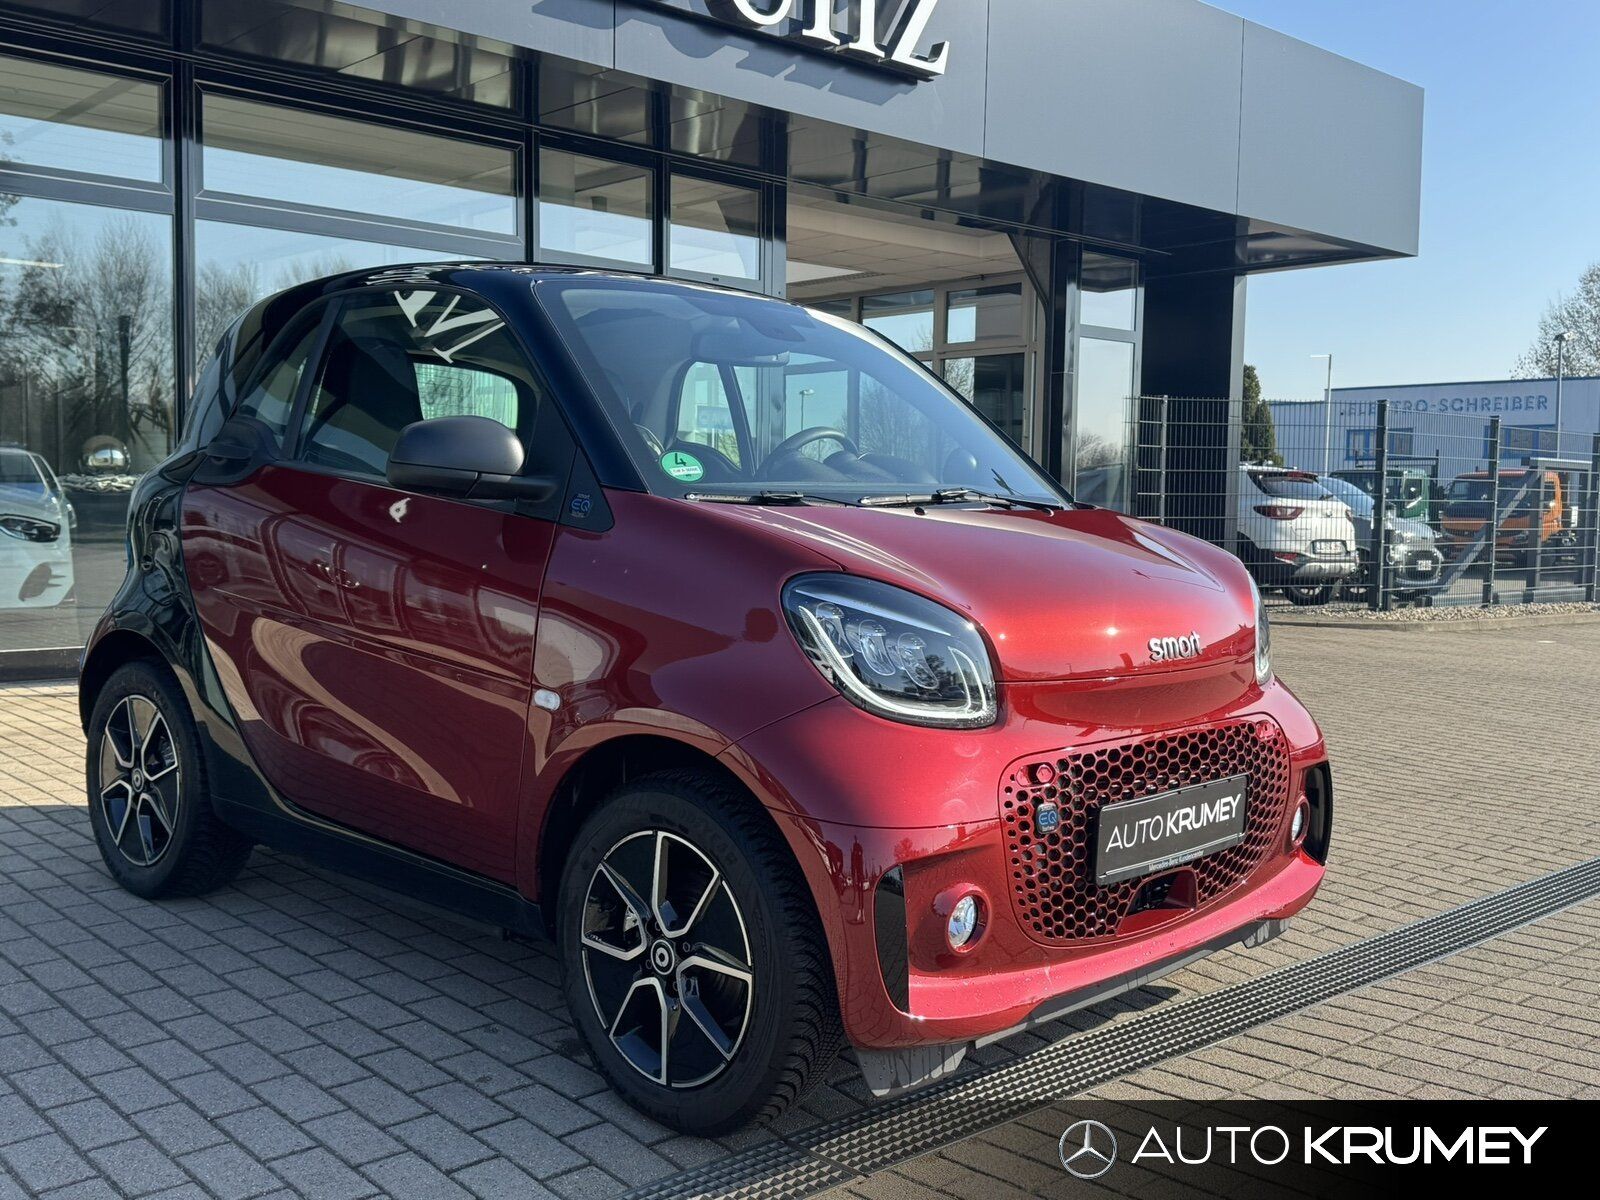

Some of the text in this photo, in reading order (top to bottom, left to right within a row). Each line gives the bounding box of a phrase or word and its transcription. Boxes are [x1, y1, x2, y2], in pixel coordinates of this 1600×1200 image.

[674, 452, 687, 466] 4
[1147, 631, 1204, 661] smart
[1105, 793, 1242, 853] AUTO KRUMEY
